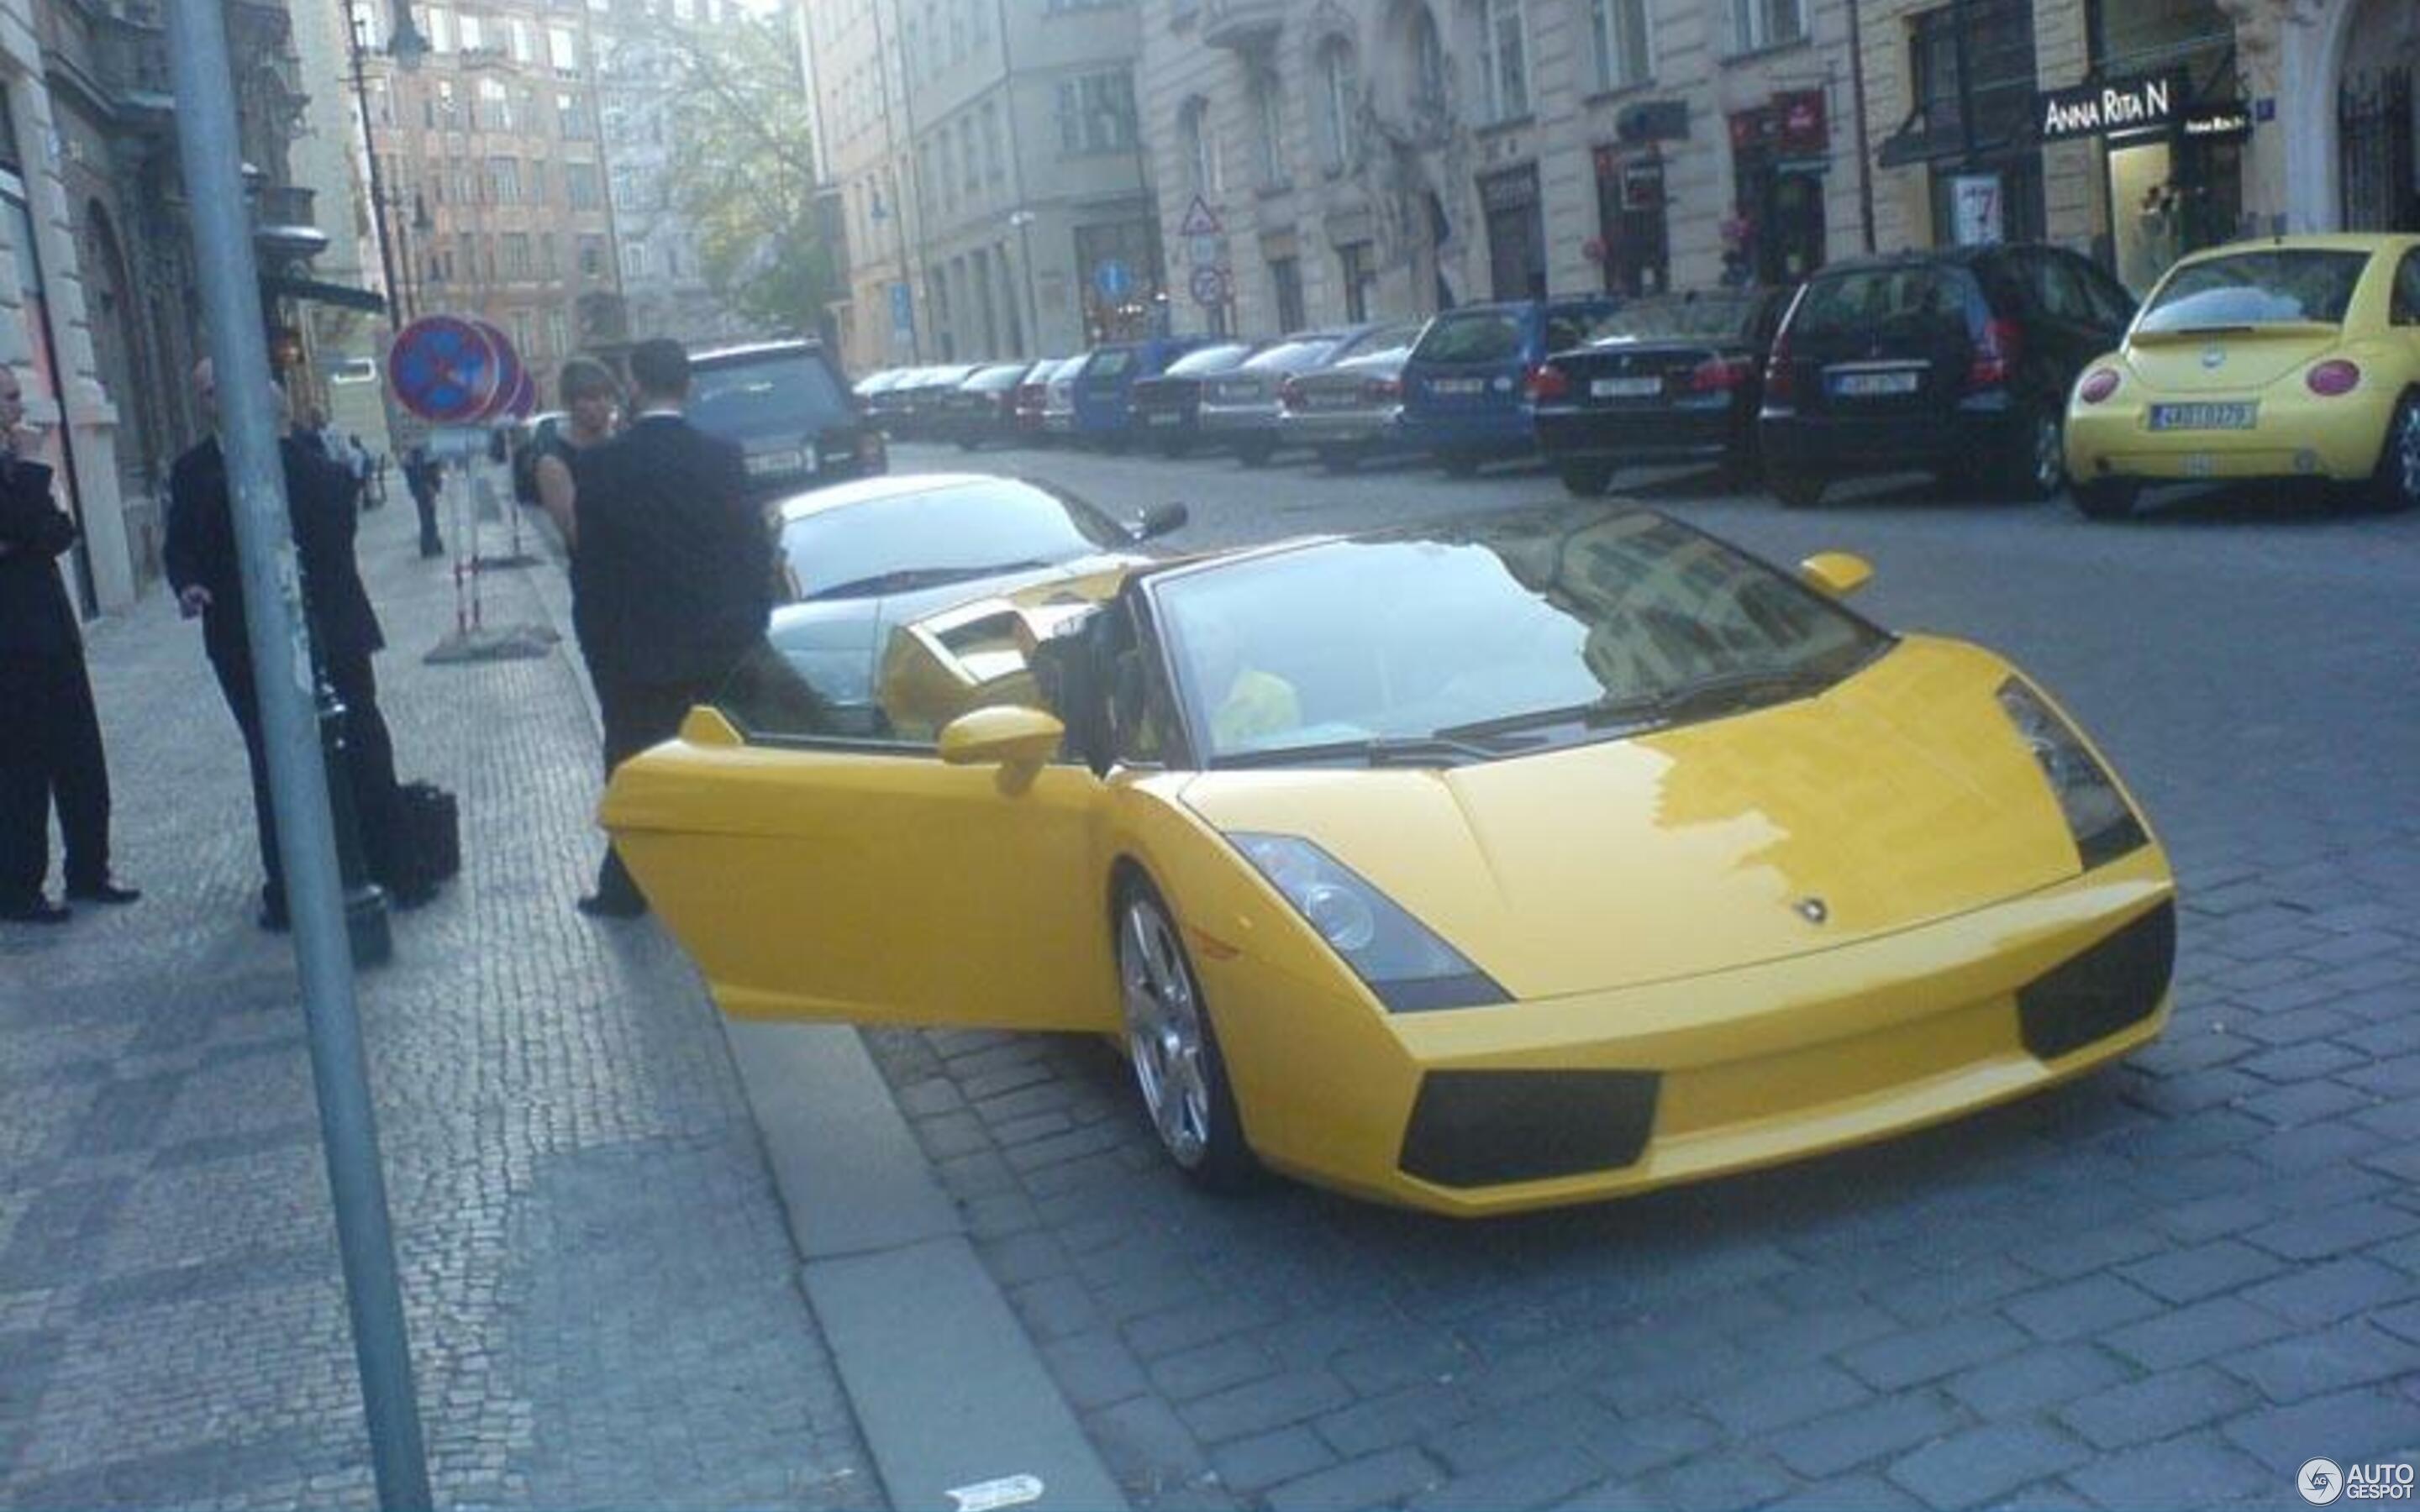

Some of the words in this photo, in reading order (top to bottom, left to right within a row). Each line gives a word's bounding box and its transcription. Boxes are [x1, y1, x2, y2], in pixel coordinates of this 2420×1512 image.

[2044, 99, 2100, 134] ANNA
[2103, 87, 2143, 125] RITA
[2146, 79, 2169, 118] N
